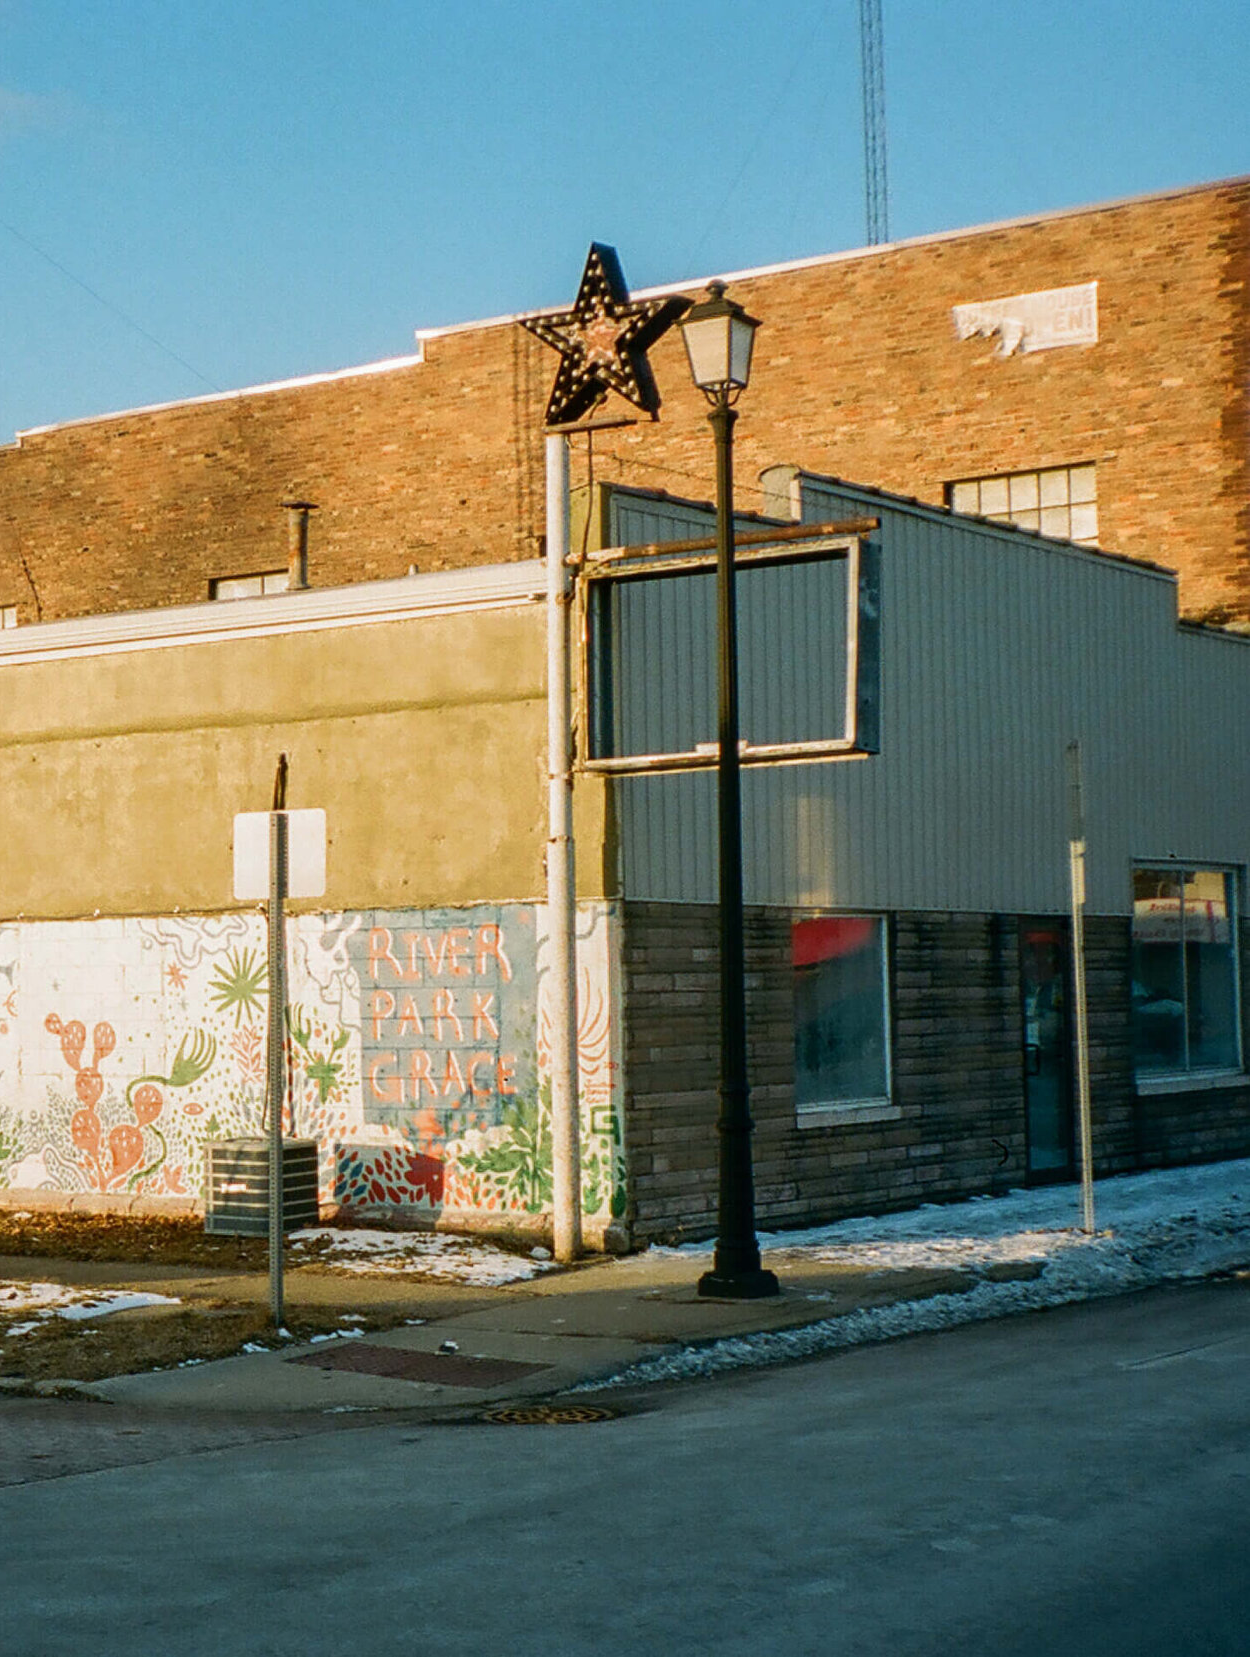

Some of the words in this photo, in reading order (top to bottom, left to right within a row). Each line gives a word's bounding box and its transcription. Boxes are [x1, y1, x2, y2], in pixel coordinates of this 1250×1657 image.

[368, 923, 512, 983] RIVER
[369, 986, 499, 1041] PARK
[368, 1049, 517, 1103] GRACE
